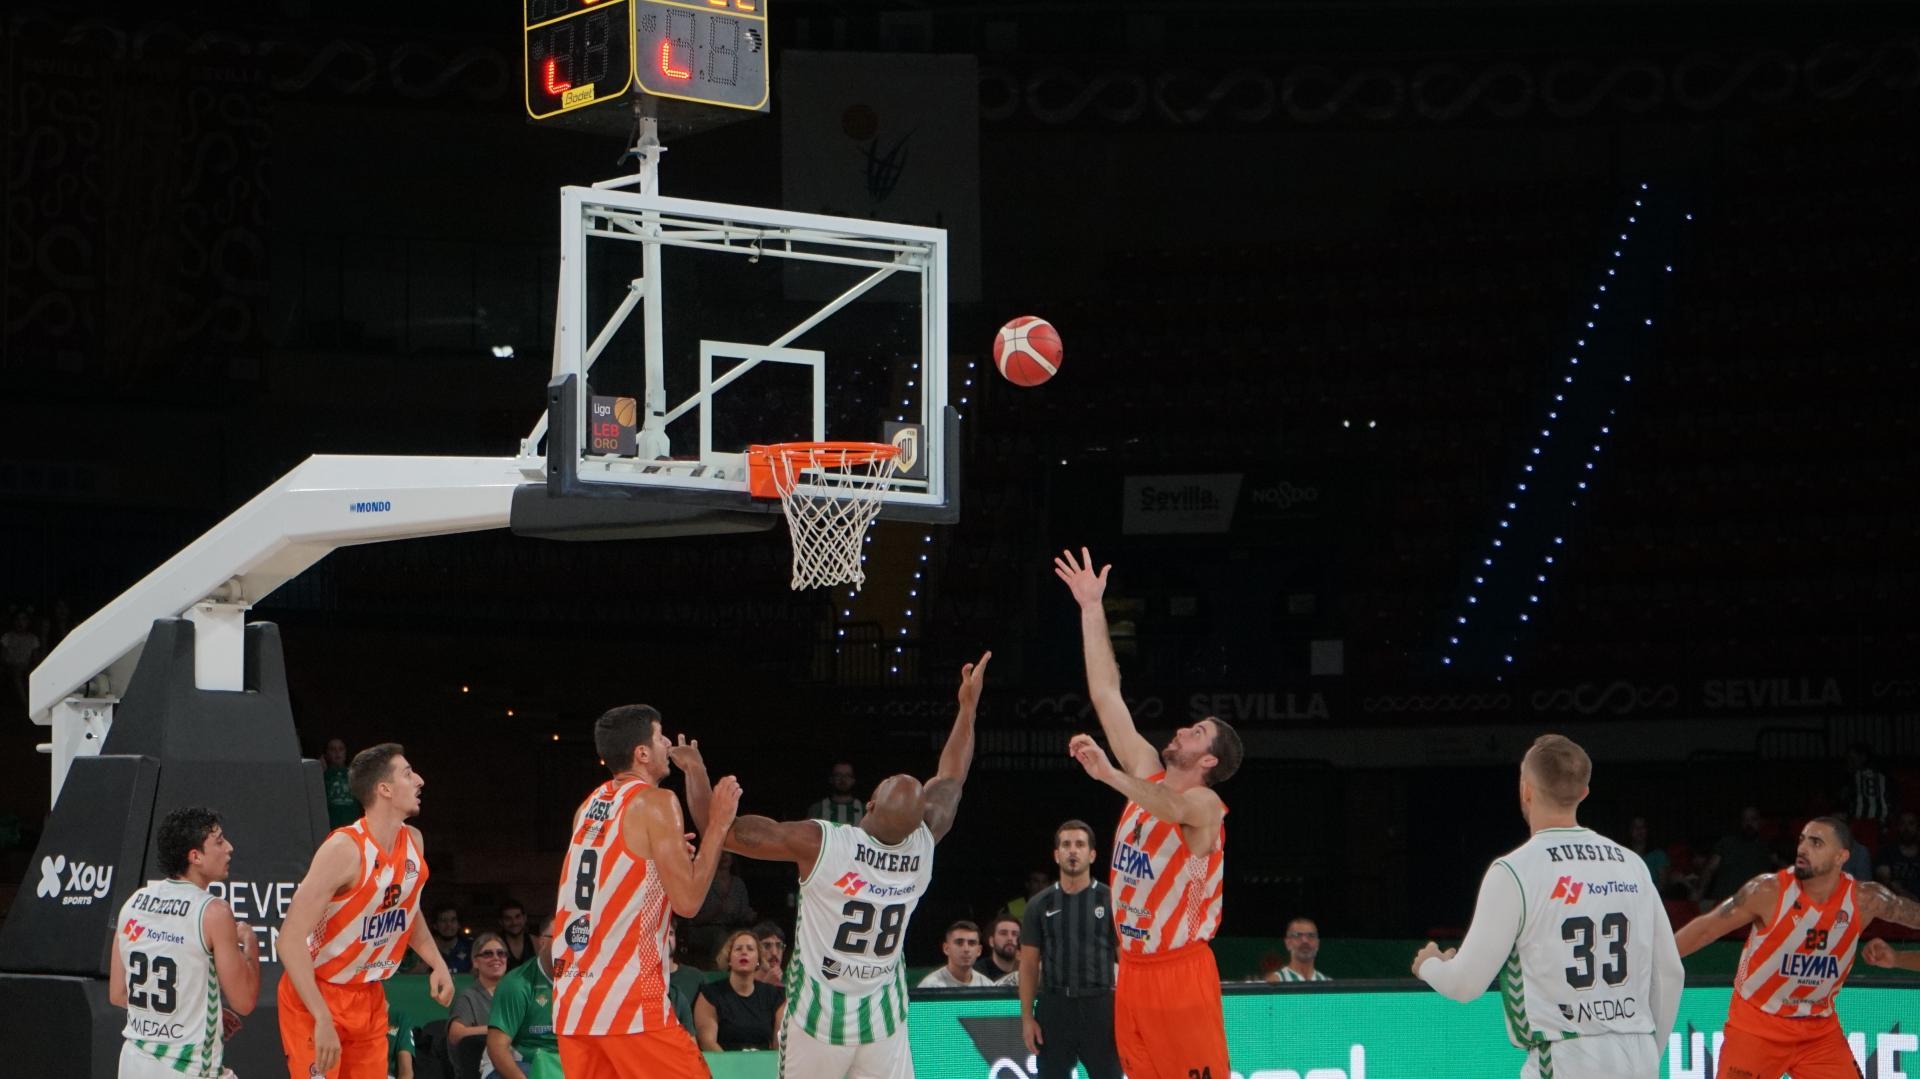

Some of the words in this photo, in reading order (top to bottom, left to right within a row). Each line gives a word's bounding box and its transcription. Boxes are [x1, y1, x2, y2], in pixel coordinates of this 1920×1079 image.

[593, 423, 619, 437] LEB
[593, 438, 618, 449] ORO
[357, 501, 391, 512] MONDO
[1703, 676, 1843, 709] SEVILLA
[1190, 690, 1330, 721] SEVILLA
[854, 843, 920, 872] ROMERO
[1113, 841, 1154, 880] LEYMA
[1547, 844, 1625, 863] KUKSIKS
[65, 862, 113, 898] Xoy
[575, 849, 598, 911] 8
[1587, 881, 1638, 896] XoyTicket
[62, 896, 93, 905] SPORTS
[131, 892, 191, 917] PACHECO
[147, 928, 185, 945] XoyTicket
[361, 909, 406, 941] LEYMA
[833, 900, 906, 957] 28
[1561, 912, 1629, 991] 33
[1805, 929, 1828, 950] 23
[1781, 954, 1839, 978] LEYMA
[128, 951, 177, 1015] 23
[1578, 998, 1635, 1023] MEDAC
